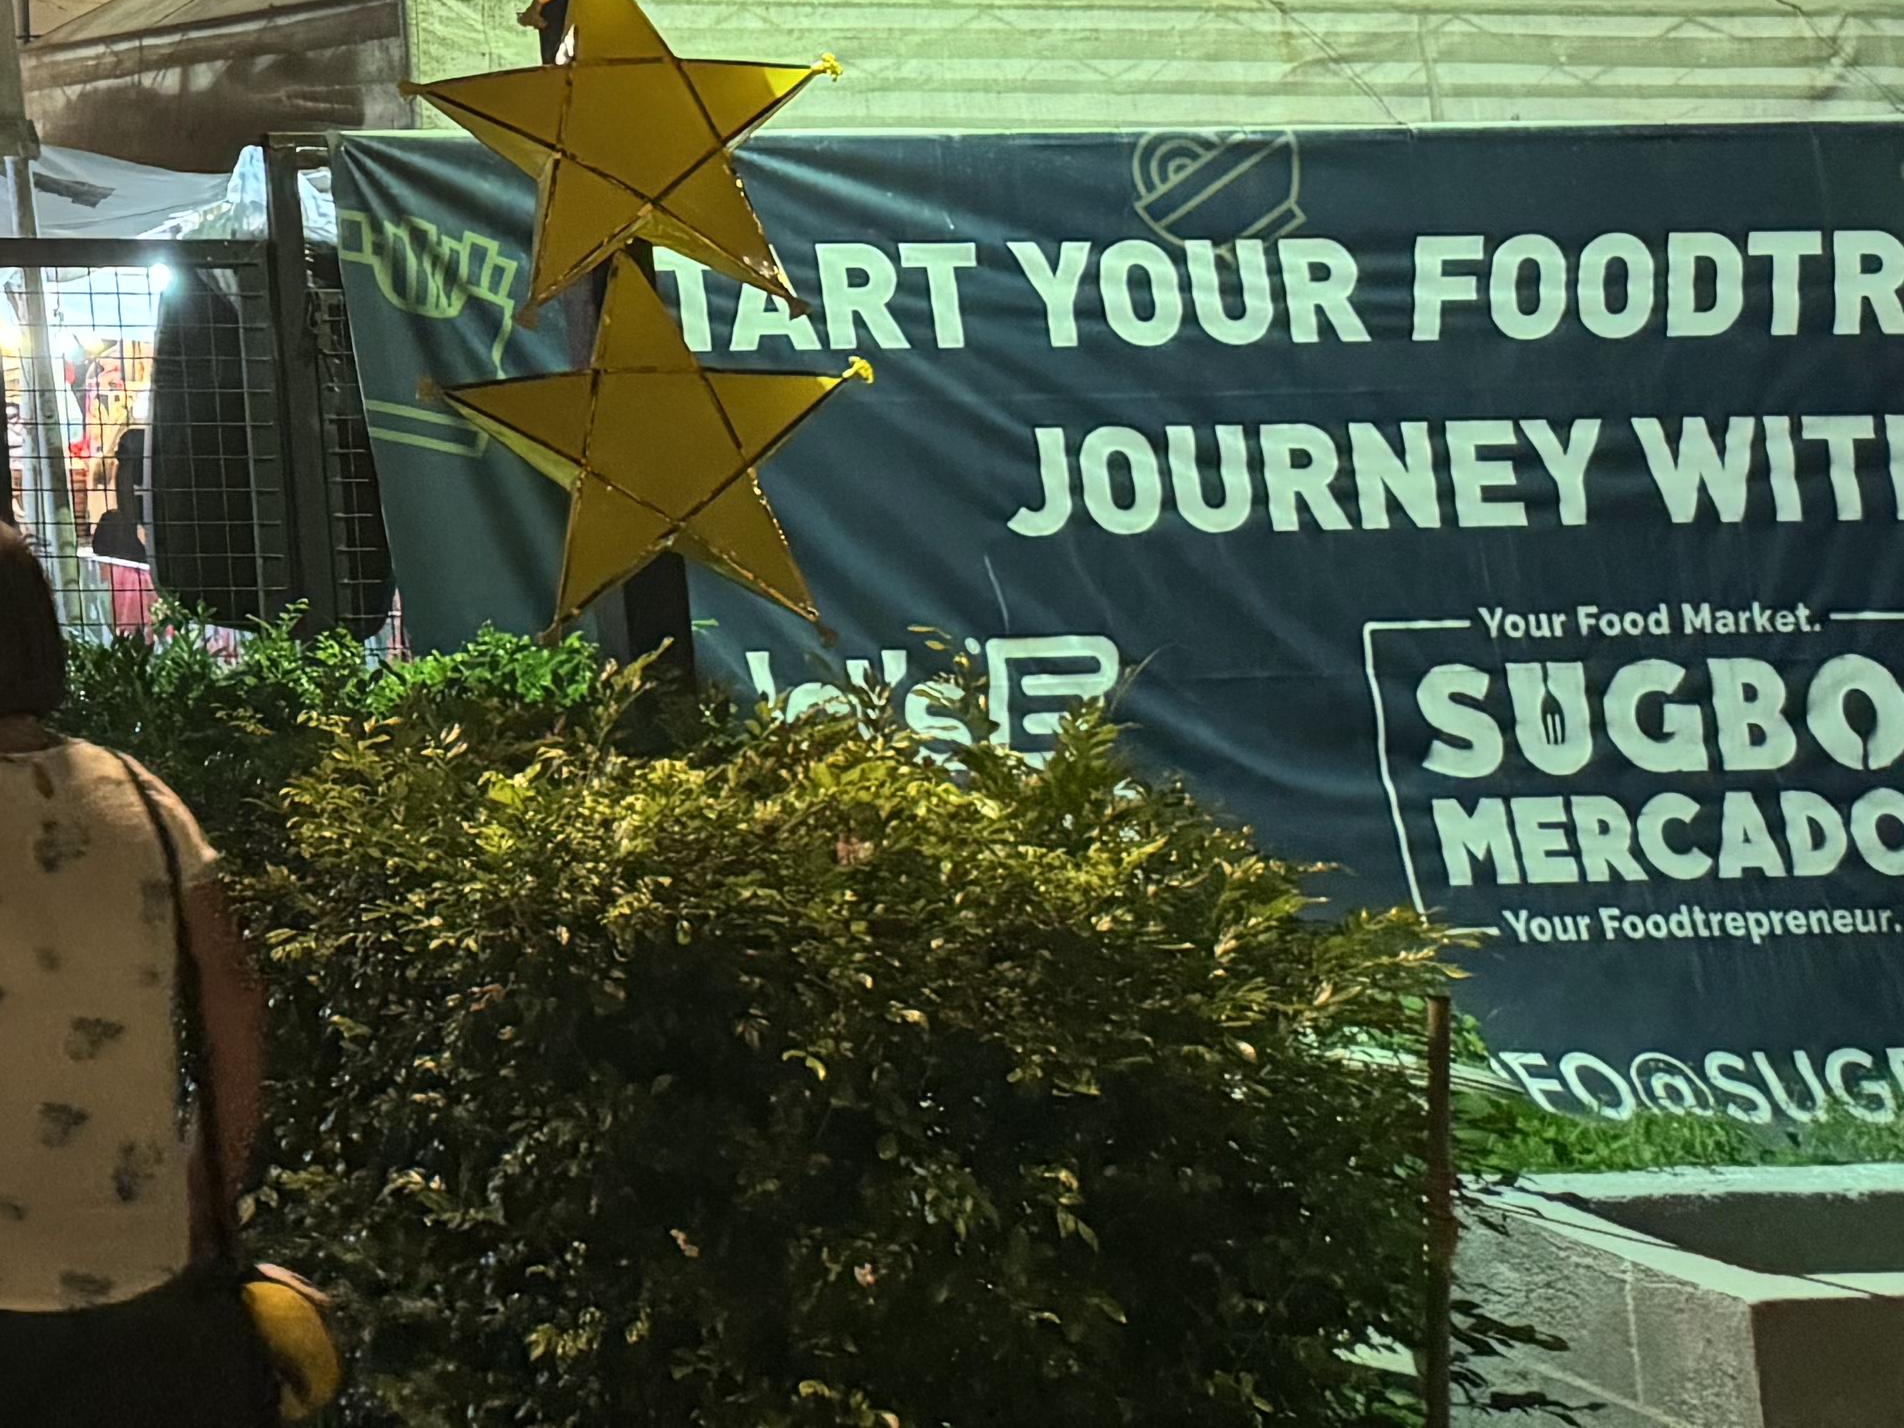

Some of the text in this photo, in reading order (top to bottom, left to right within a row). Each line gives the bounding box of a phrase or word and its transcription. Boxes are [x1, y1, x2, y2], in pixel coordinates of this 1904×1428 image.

[652, 230, 1904, 352] TART YOUR FOODTR
[1006, 414, 1904, 537] JOURNEY WIT
[1479, 601, 1822, 638] Your Food Market.
[1415, 654, 1904, 778] SUGBO
[1431, 787, 1904, 887] MERCADO
[1502, 903, 1903, 944] Your Foodtrepreneur.
[1490, 1047, 1904, 1124] FO@SUG
